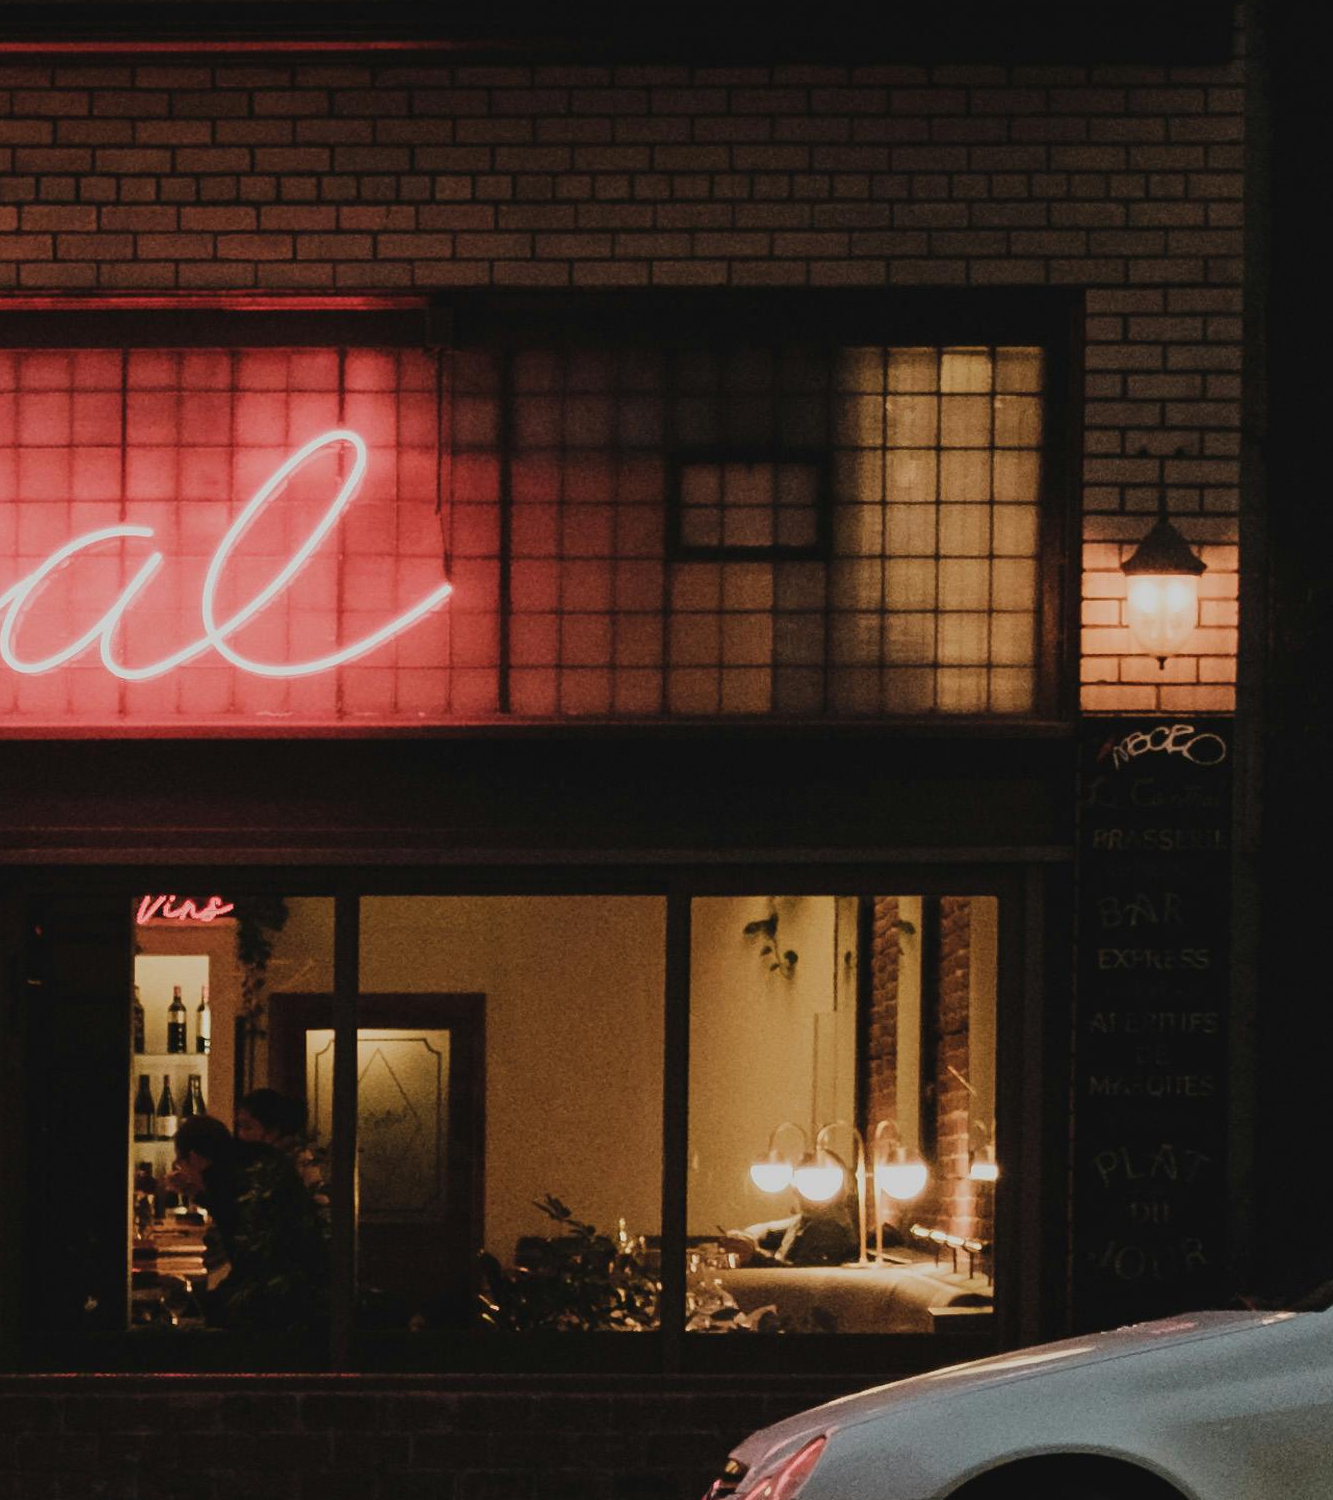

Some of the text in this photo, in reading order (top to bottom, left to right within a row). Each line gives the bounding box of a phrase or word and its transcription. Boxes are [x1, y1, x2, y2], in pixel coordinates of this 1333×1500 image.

[136, 895, 234, 924] Vins
[1097, 948, 1211, 971] EXPRESS
[1093, 1143, 1211, 1188] PLAT
